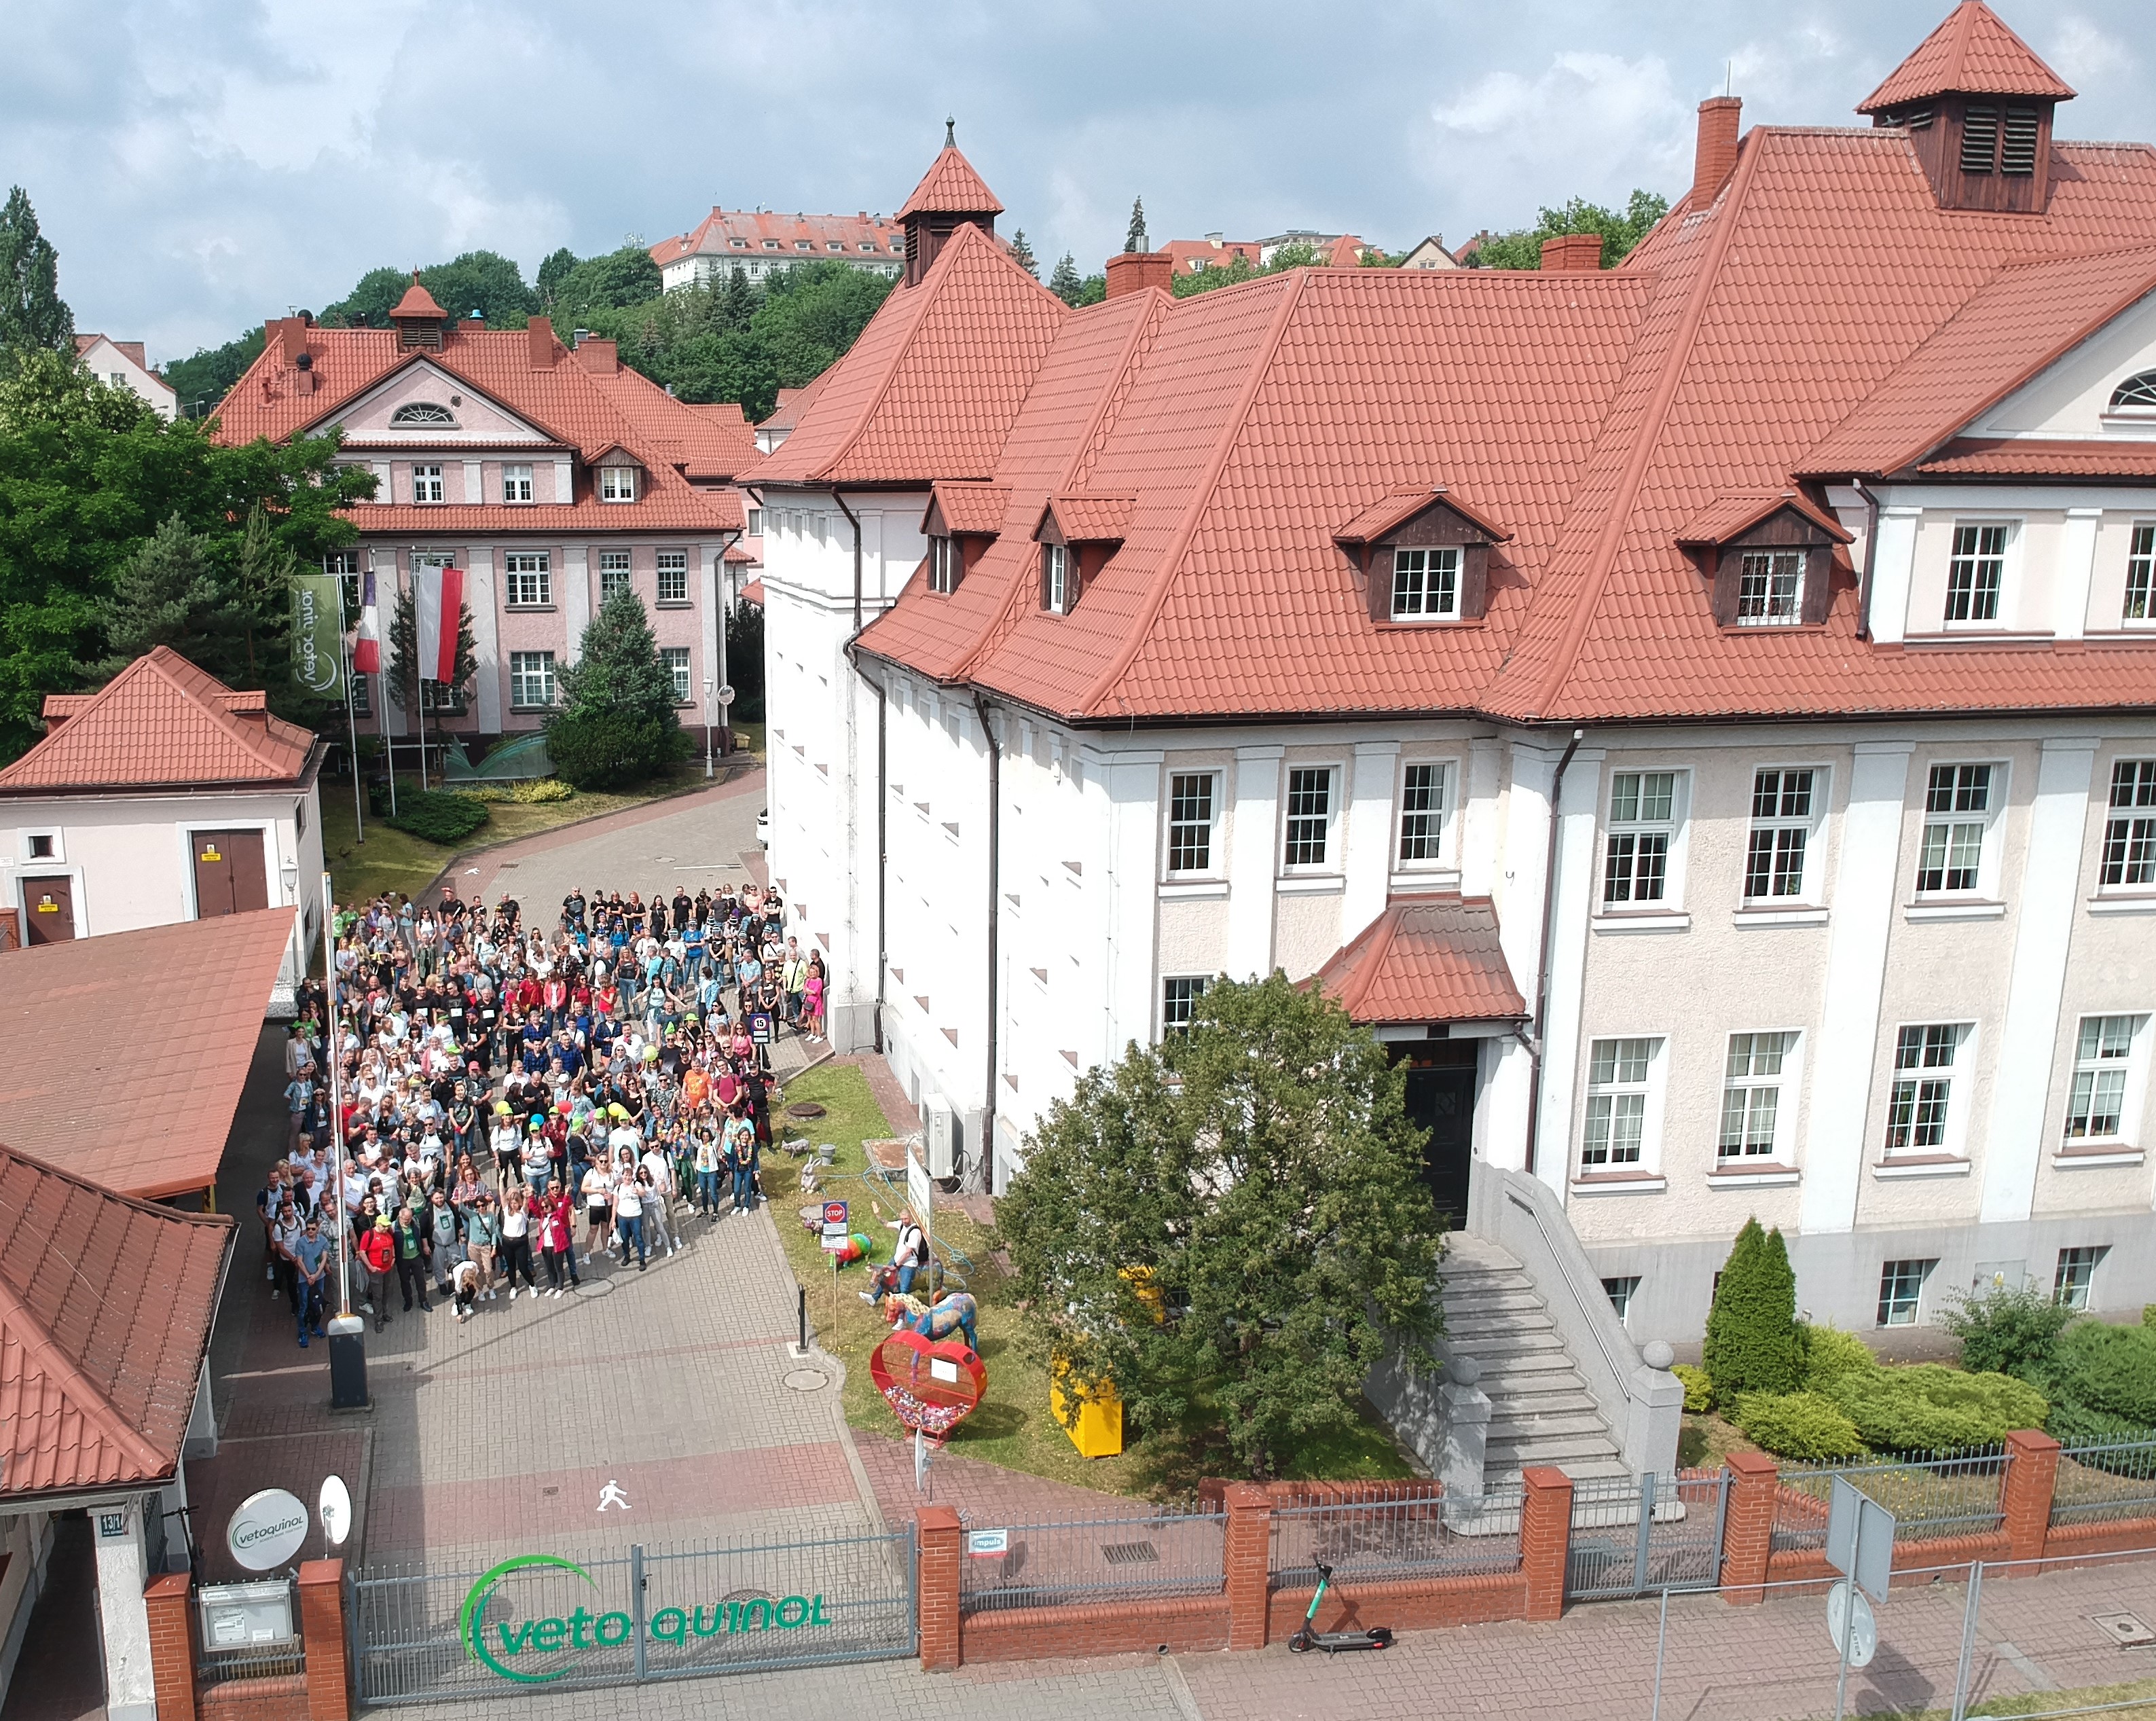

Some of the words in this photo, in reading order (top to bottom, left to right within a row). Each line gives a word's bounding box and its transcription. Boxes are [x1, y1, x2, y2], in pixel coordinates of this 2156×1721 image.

[103, 1515, 123, 1529] 13/1
[240, 1516, 304, 1544] vetoquinol
[974, 1538, 1001, 1546] impuls
[497, 1606, 632, 1655] veto
